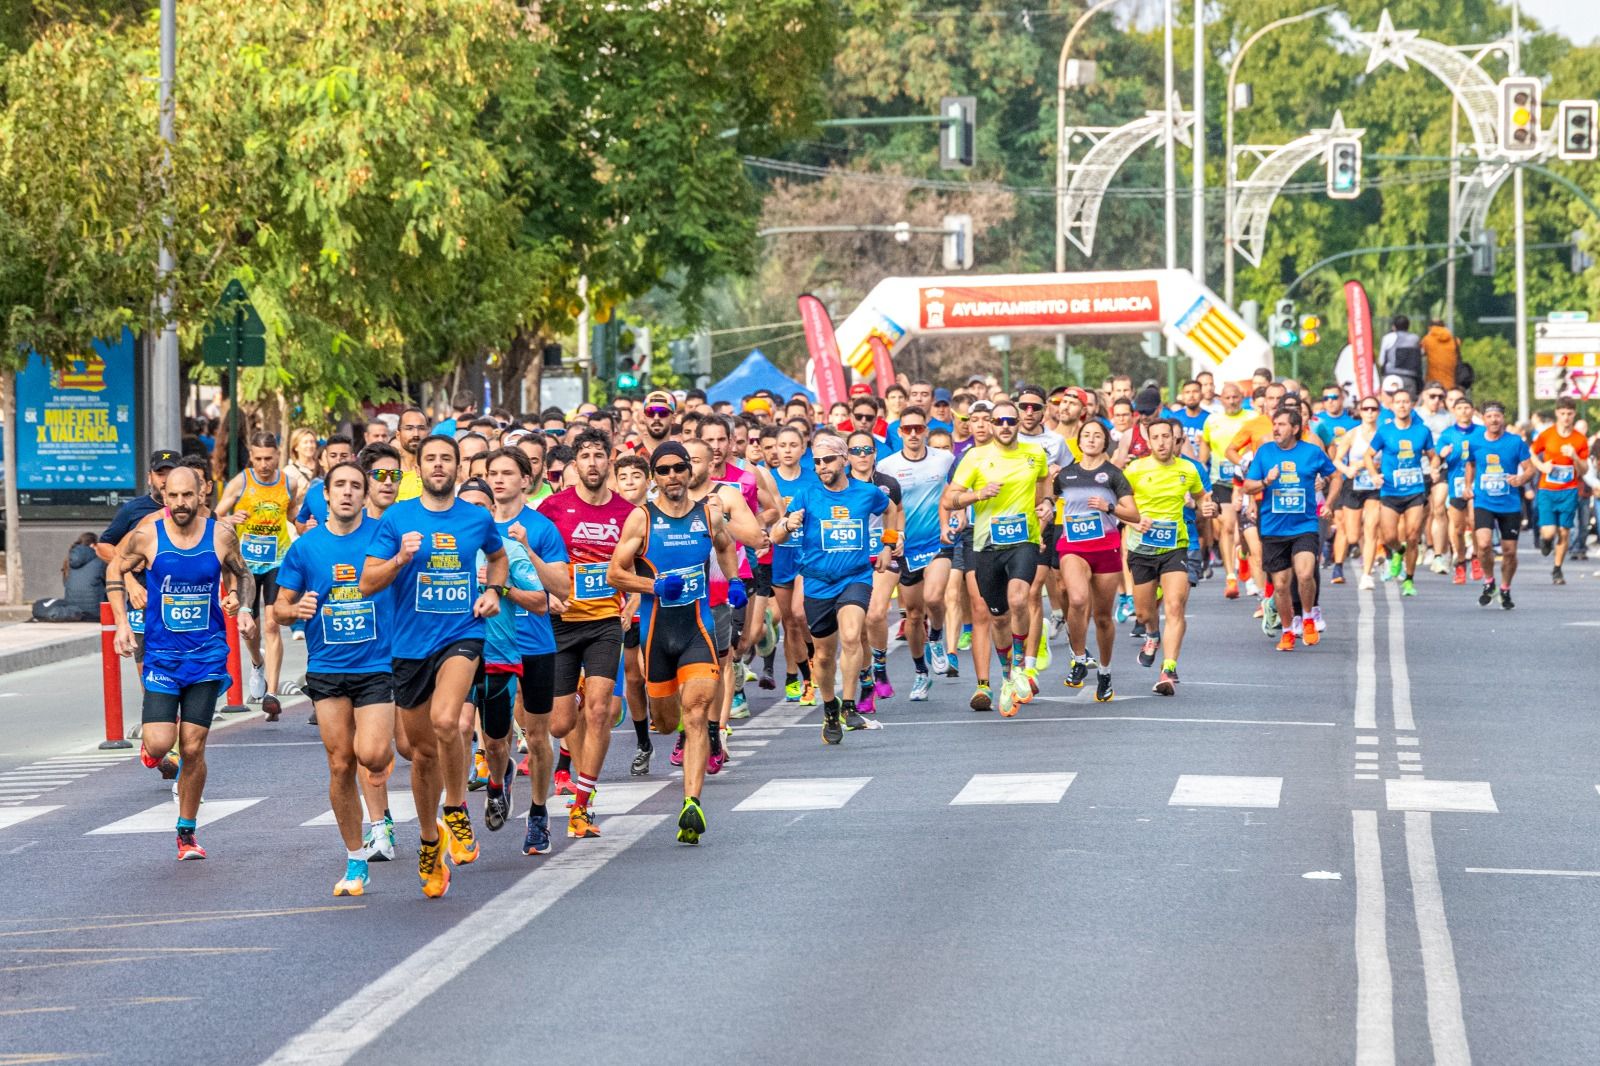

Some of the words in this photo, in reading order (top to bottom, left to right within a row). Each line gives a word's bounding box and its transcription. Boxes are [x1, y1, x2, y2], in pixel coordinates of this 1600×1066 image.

[952, 299, 1068, 317] AYUNTAMIENTO
[1070, 299, 1091, 314] DE
[1093, 296, 1152, 313] MURCIA
[44, 405, 109, 426] MUÉVETE
[36, 425, 47, 443] X
[49, 425, 119, 443] VALENCIA
[1279, 496, 1300, 506] 192
[998, 523, 1023, 536] 564
[1072, 520, 1096, 534] 604
[1149, 528, 1172, 540] 765
[829, 528, 857, 541] 450
[246, 544, 271, 555] 487
[584, 574, 609, 588] 91
[682, 578, 699, 593] 45
[421, 586, 467, 601] 4106
[171, 606, 202, 620] 662
[332, 615, 366, 632] 532
